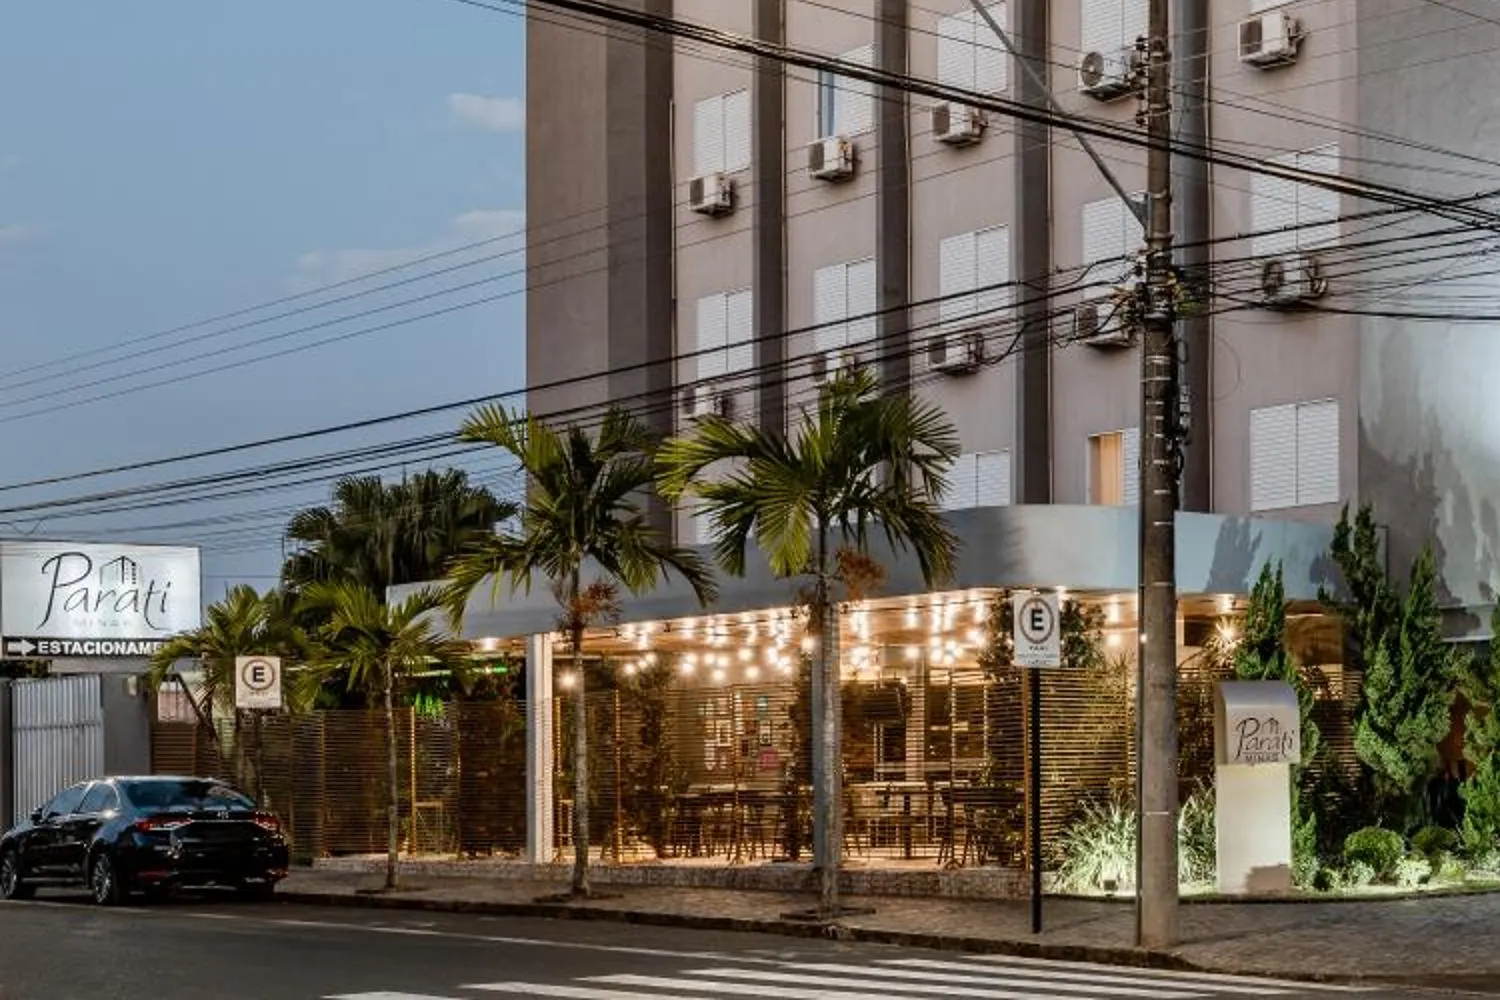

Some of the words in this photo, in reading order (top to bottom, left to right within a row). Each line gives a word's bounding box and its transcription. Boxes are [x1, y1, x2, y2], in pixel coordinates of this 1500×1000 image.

[36, 551, 172, 631] Parati
[1030, 608, 1045, 631] E
[37, 641, 162, 655] ESTACIONAME
[252, 665, 266, 683] E
[1234, 716, 1296, 761] Parati
